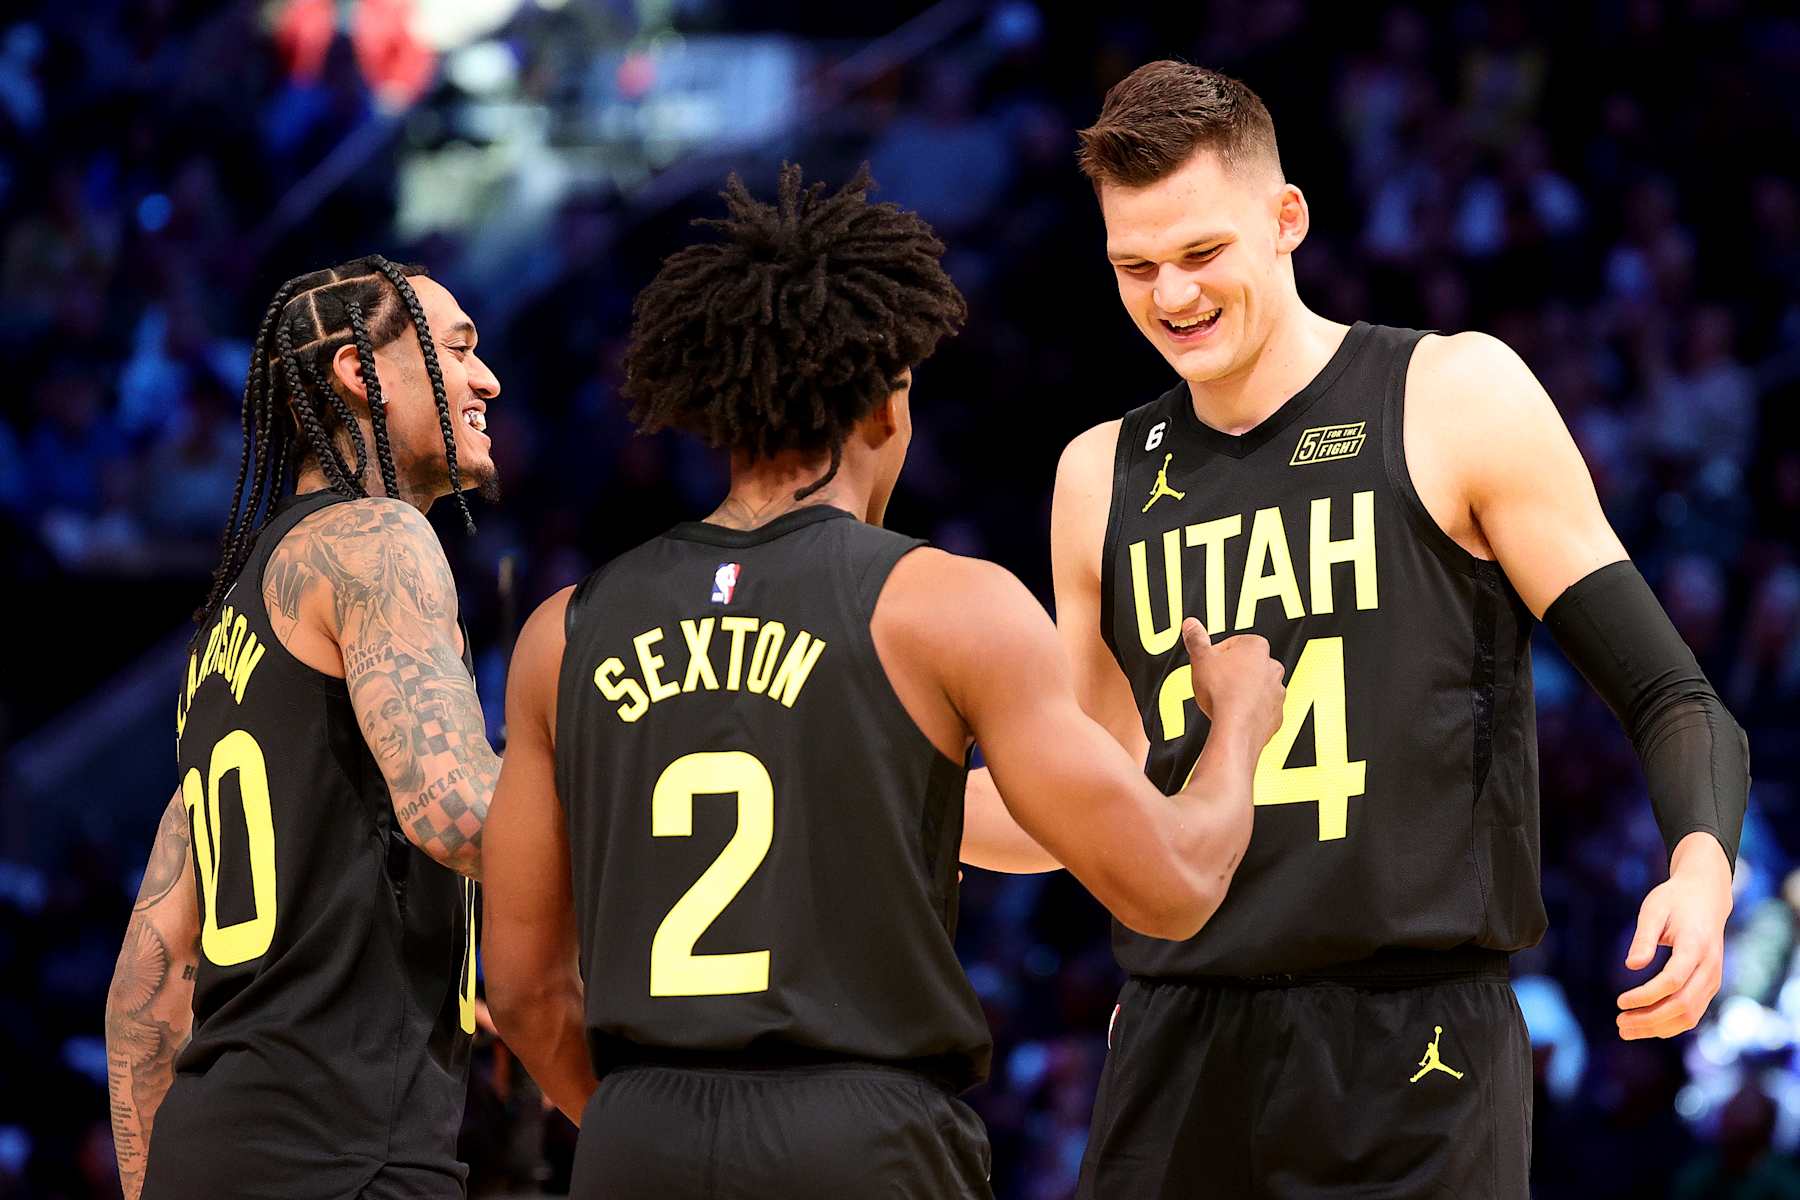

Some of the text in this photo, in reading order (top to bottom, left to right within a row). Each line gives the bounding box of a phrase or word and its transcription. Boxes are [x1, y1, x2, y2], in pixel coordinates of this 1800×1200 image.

[1145, 422, 1166, 451] 6
[1299, 433, 1320, 460] 5
[1326, 428, 1358, 439] FOR THE
[1318, 440, 1359, 457] FIGHT
[1129, 490, 1379, 656] UTAH
[593, 616, 827, 723] SEXTON
[650, 750, 775, 998] 2
